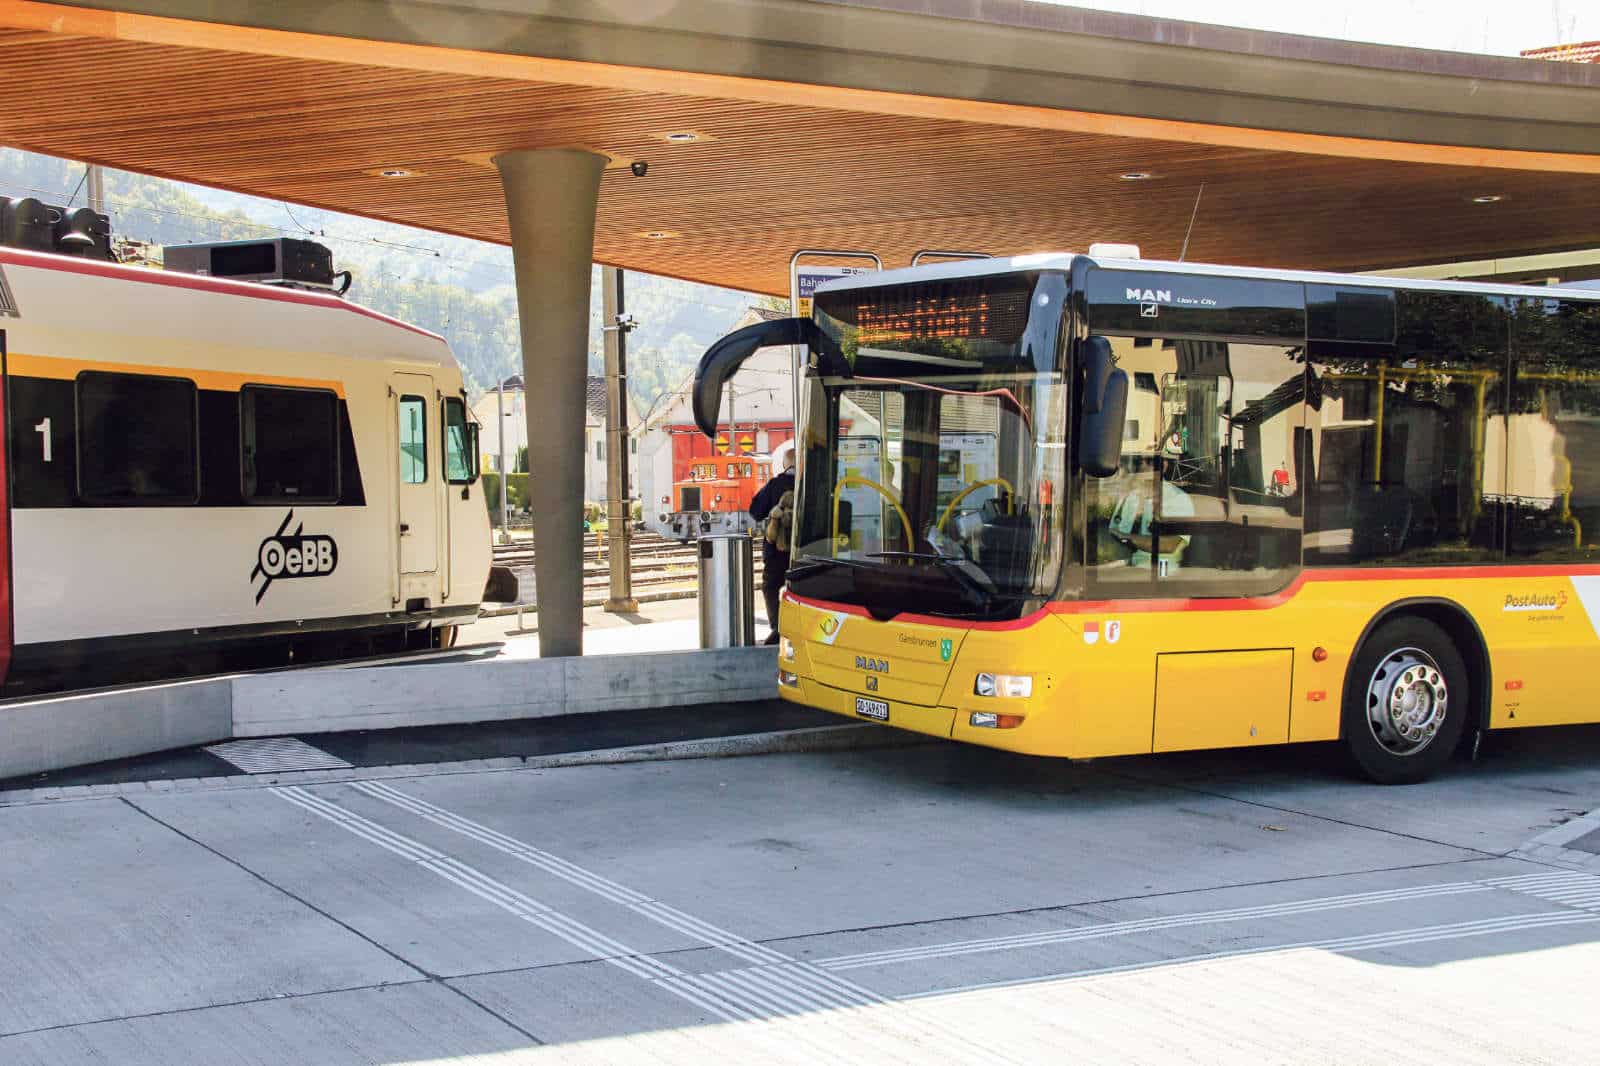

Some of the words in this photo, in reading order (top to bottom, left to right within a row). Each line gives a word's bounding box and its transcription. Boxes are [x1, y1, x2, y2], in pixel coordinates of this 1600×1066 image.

[1126, 287, 1171, 303] MAN
[1200, 297, 1217, 306] City
[34, 416, 52, 462] 1
[260, 539, 335, 576] OeBB
[1504, 594, 1556, 608] PostAuto
[855, 655, 889, 673] MAN
